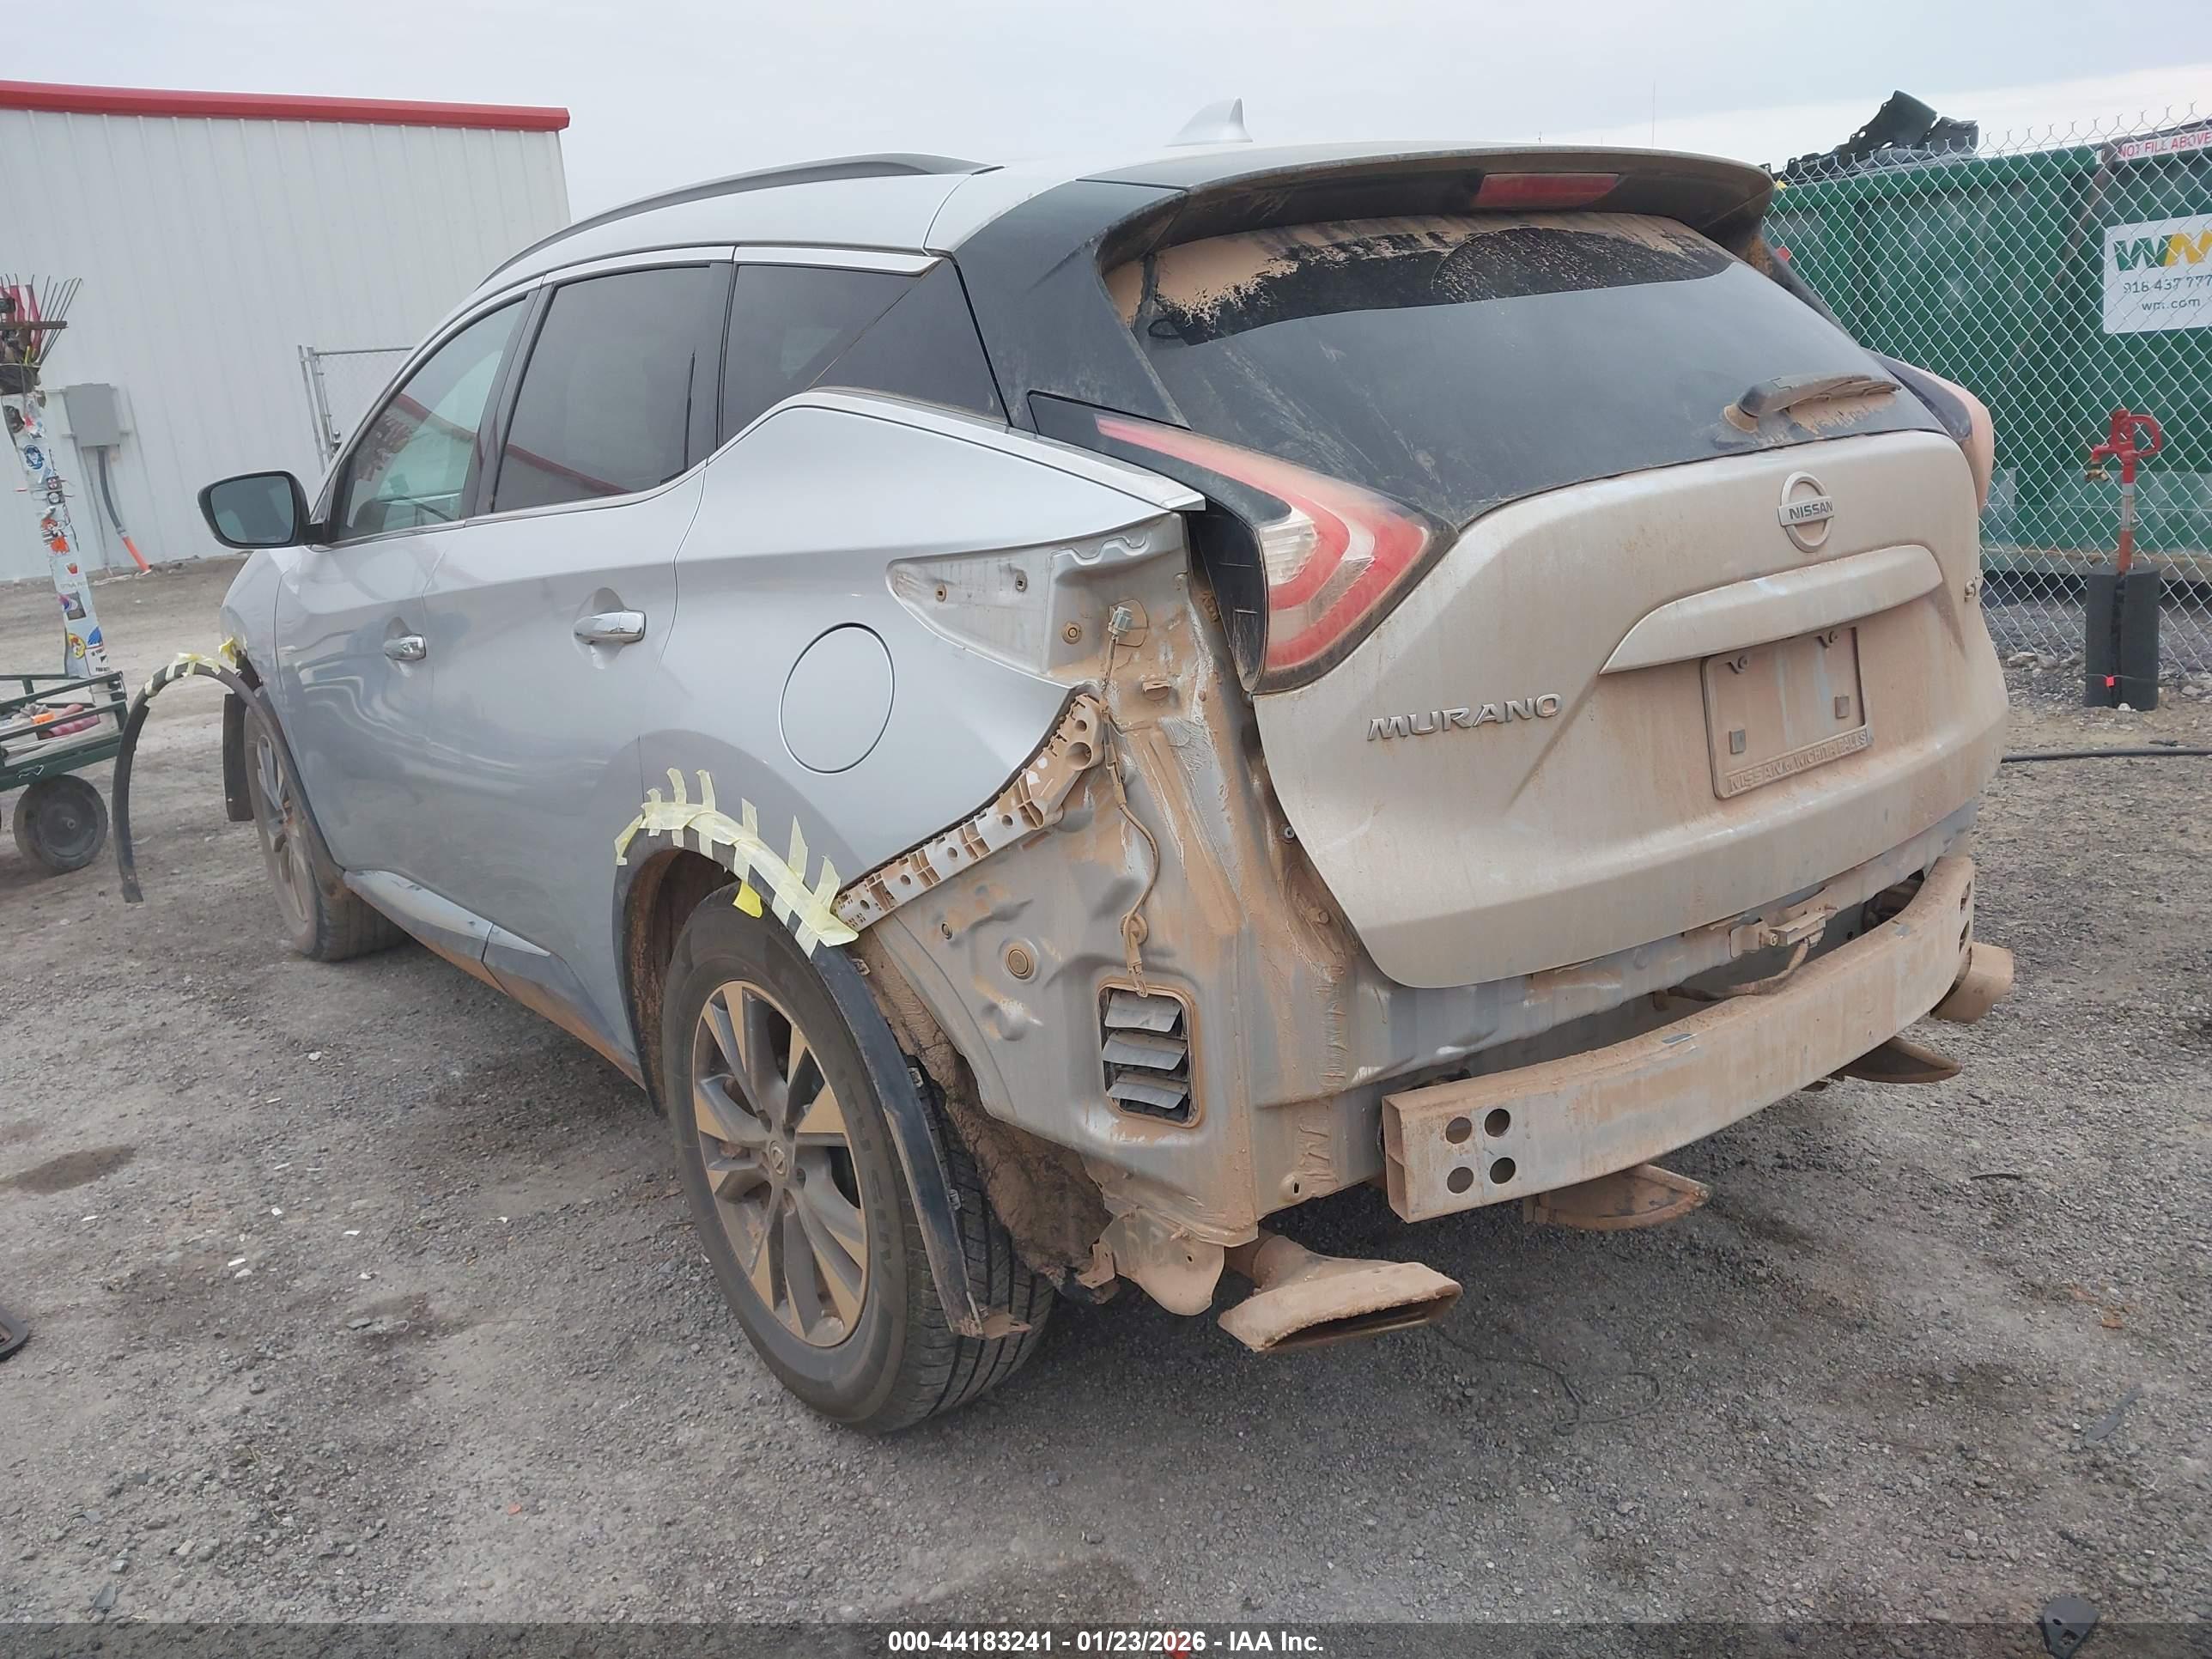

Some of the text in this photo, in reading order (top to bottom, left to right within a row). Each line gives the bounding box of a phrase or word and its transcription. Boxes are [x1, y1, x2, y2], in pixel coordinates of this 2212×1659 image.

[2144, 140, 2167, 153] FILL
[2170, 131, 2212, 149] ABOVE
[2142, 297, 2201, 311] wm.com
[1789, 501, 1833, 520] NISSAN
[1367, 693, 1563, 741] MURANO
